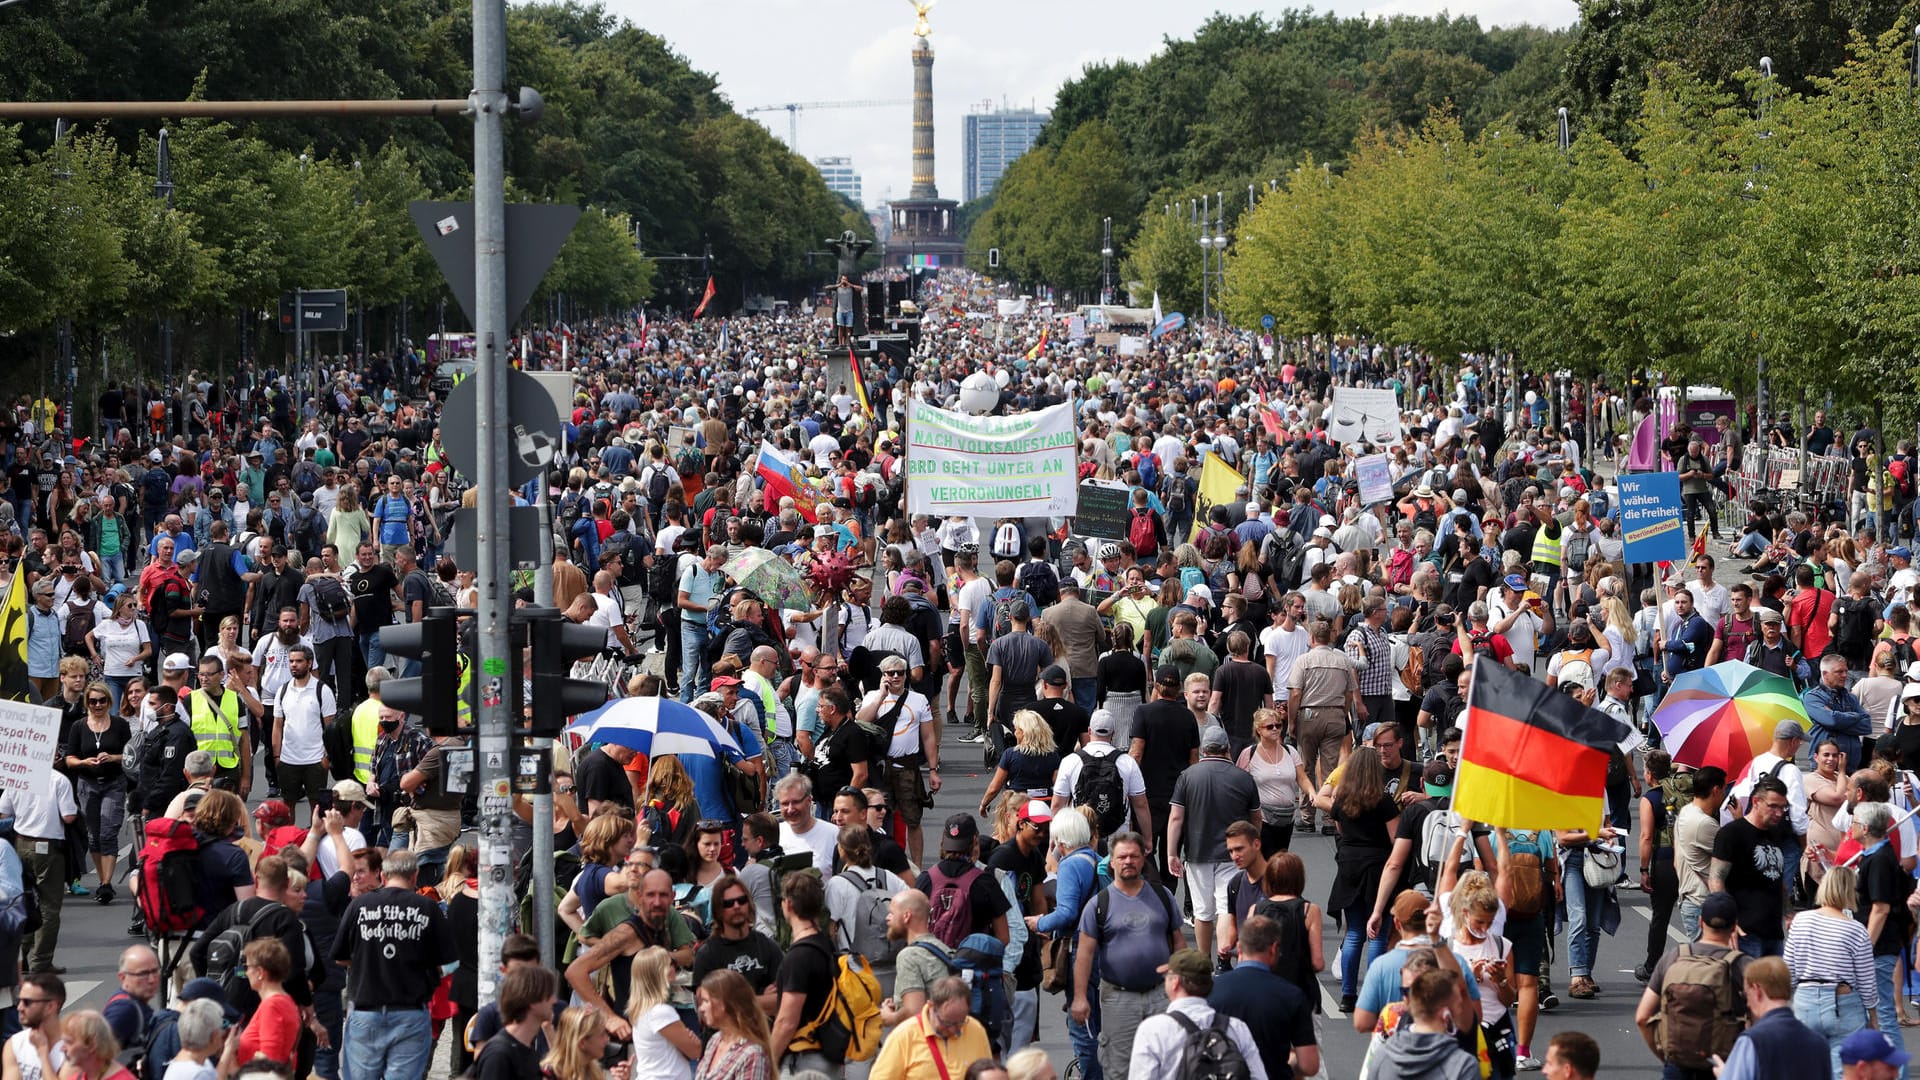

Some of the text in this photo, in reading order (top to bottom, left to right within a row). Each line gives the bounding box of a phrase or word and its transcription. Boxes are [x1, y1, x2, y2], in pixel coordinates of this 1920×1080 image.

[914, 430, 1075, 453] NACH VOLKSAUFSTAND
[908, 459, 1063, 475] BRD GEHT UNTER AN
[930, 484, 1042, 501] VERORDNUNGEN
[1622, 482, 1640, 492] Wir
[1623, 495, 1660, 506] wählen
[1624, 506, 1680, 519] die Freiheit
[1628, 521, 1677, 540] #berlinerfreiheit
[31, 708, 54, 726] hat
[31, 749, 54, 762] und
[357, 905, 430, 930] And We Play
